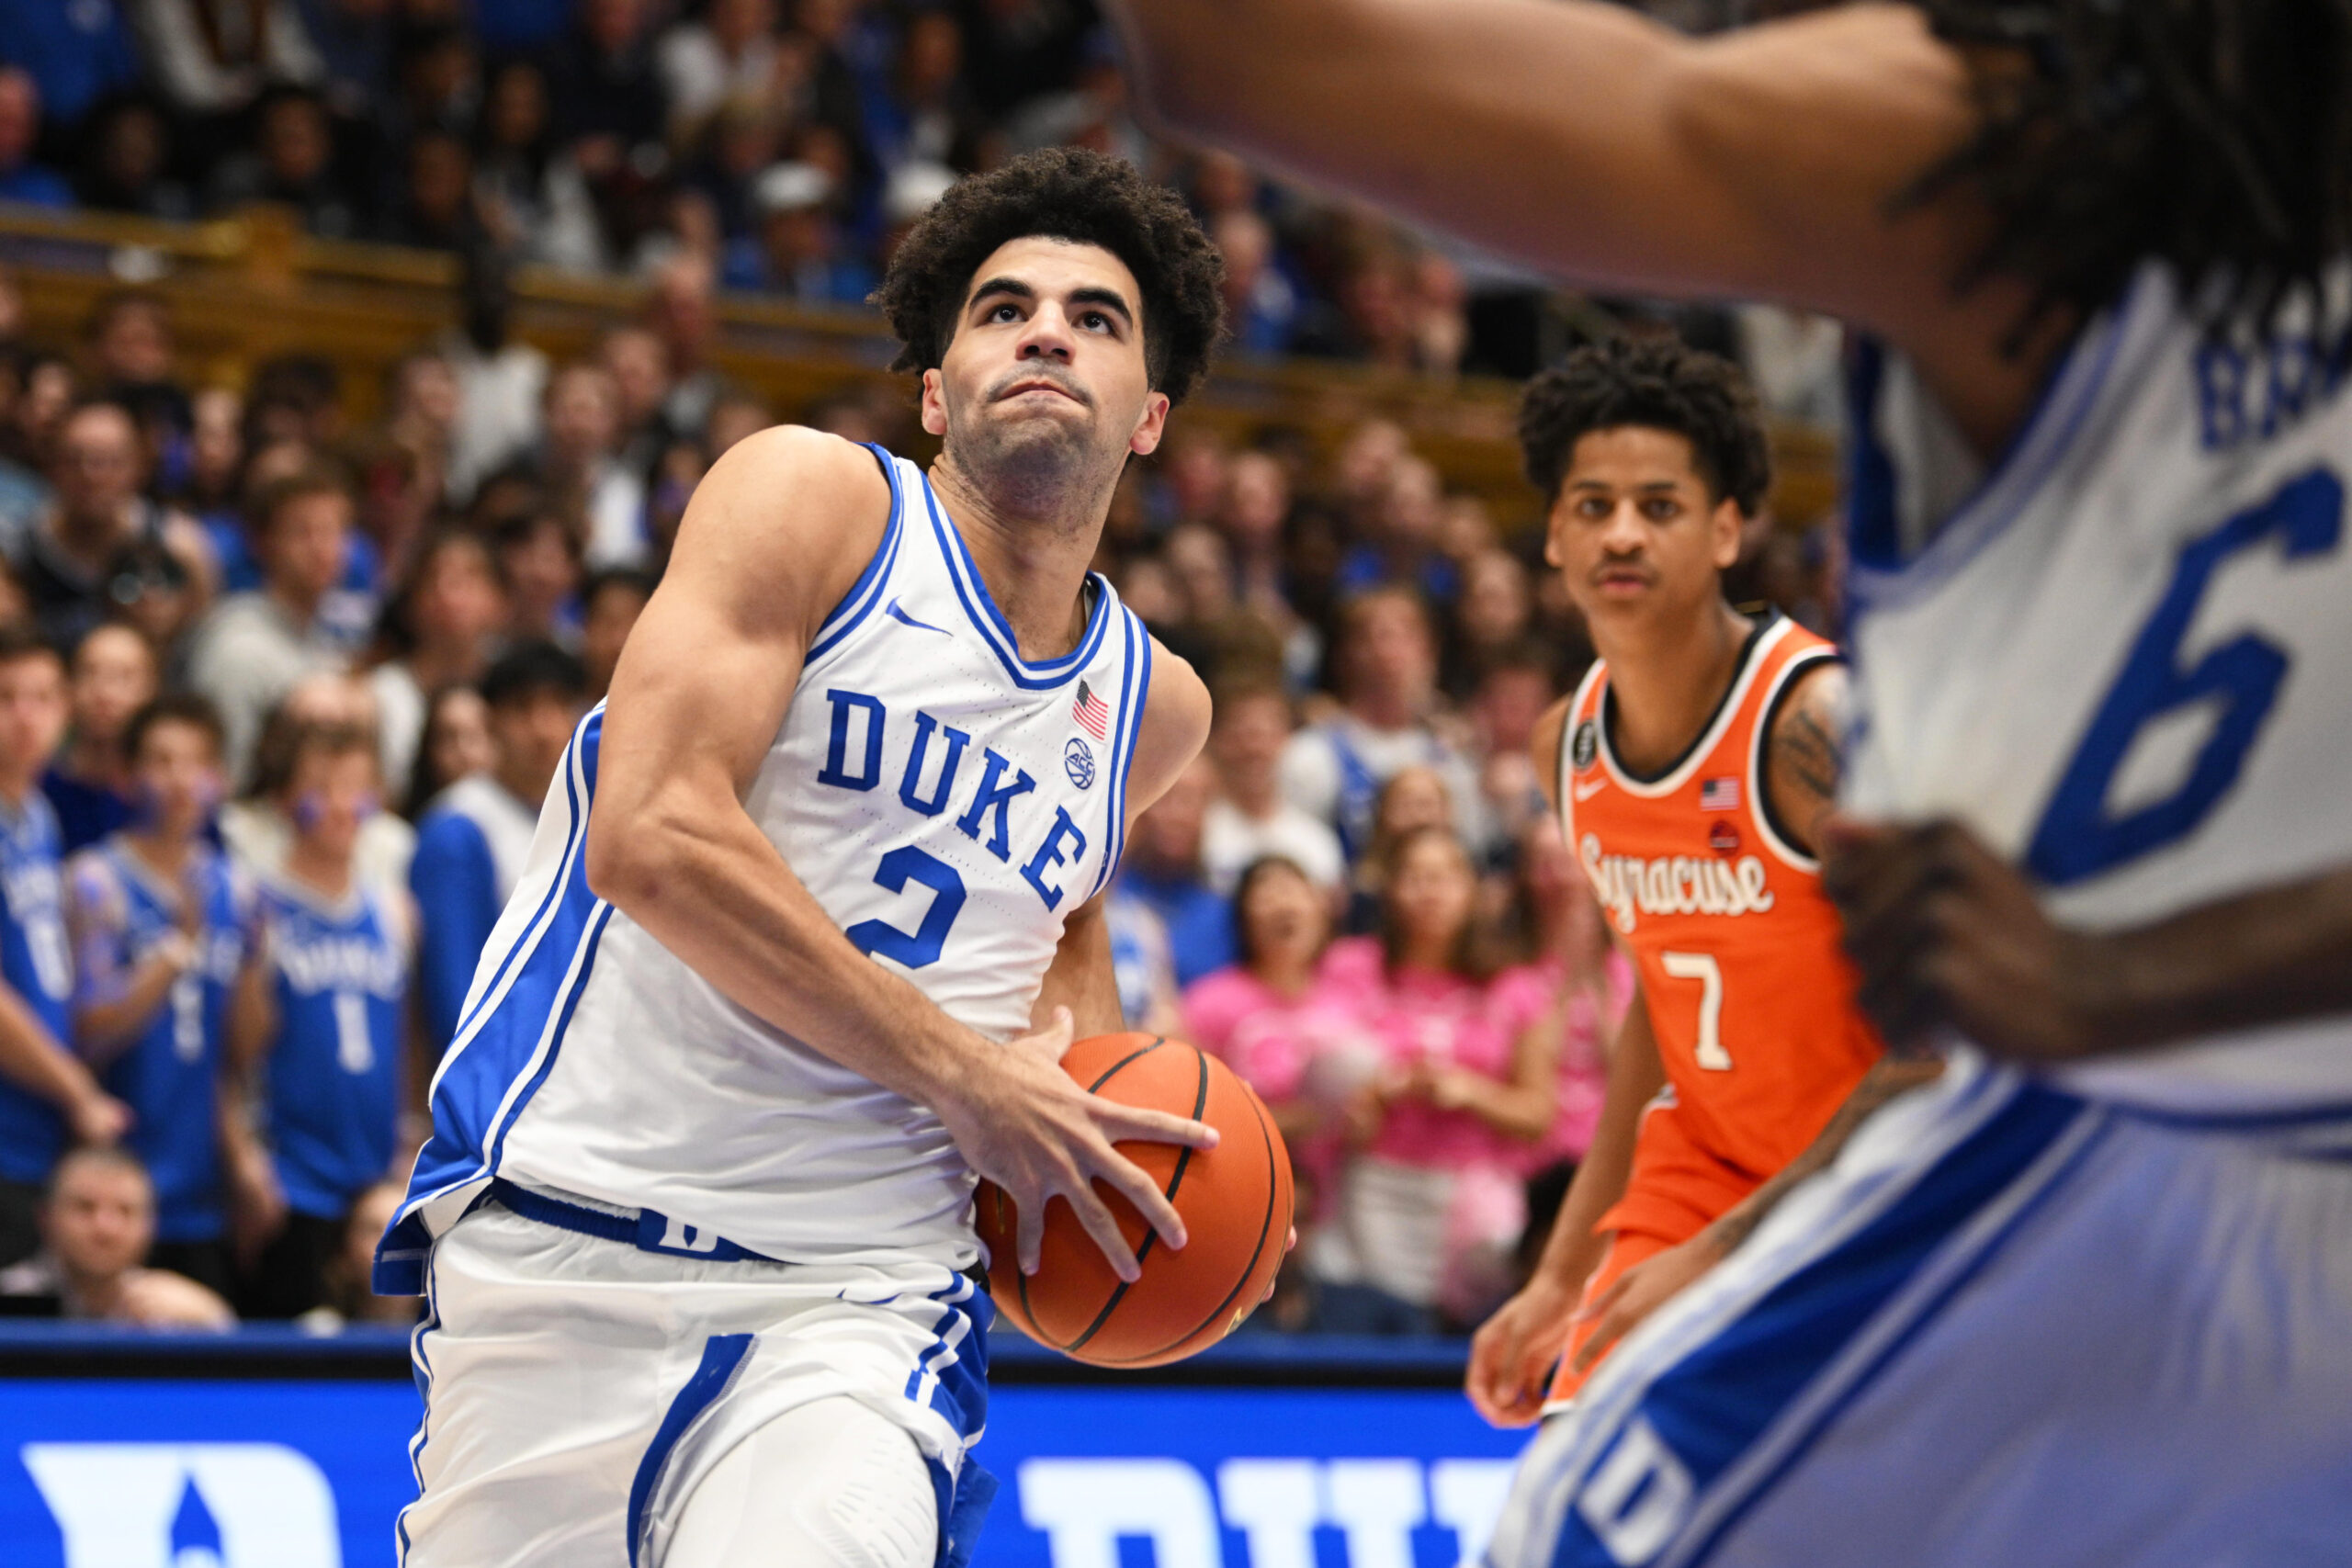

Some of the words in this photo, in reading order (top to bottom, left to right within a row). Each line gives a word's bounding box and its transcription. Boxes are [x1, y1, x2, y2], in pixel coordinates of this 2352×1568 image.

[2021, 462, 2346, 889] 6
[817, 688, 1088, 913] DUKE
[846, 845, 967, 970] 2
[1579, 832, 1775, 934] Syracuse
[1661, 951, 1733, 1071] 7
